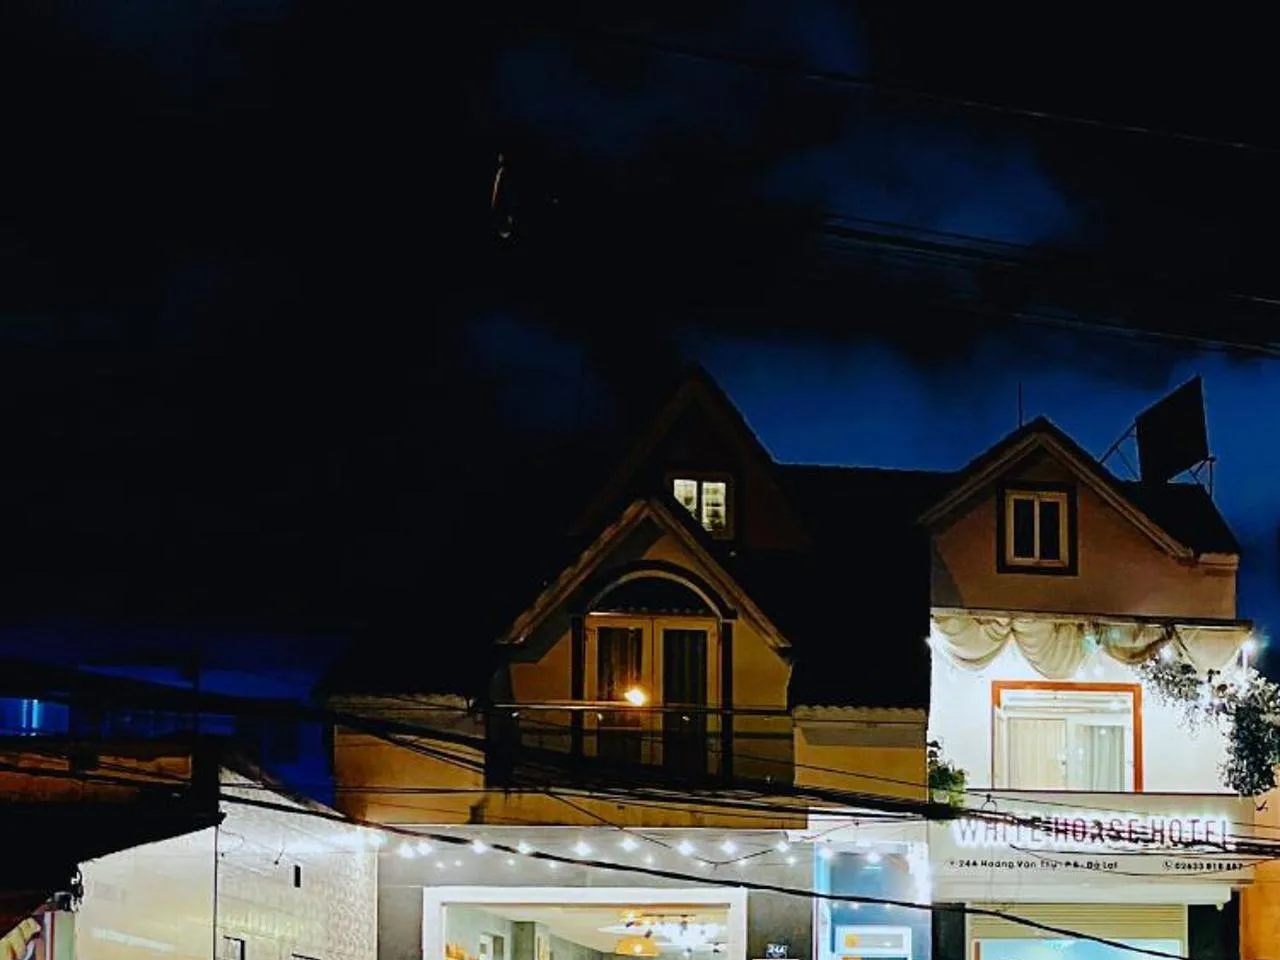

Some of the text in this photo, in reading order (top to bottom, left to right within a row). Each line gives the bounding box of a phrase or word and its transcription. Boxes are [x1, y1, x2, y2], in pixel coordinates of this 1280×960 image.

[959, 817, 1230, 845] WHITE HORSE HOTEL
